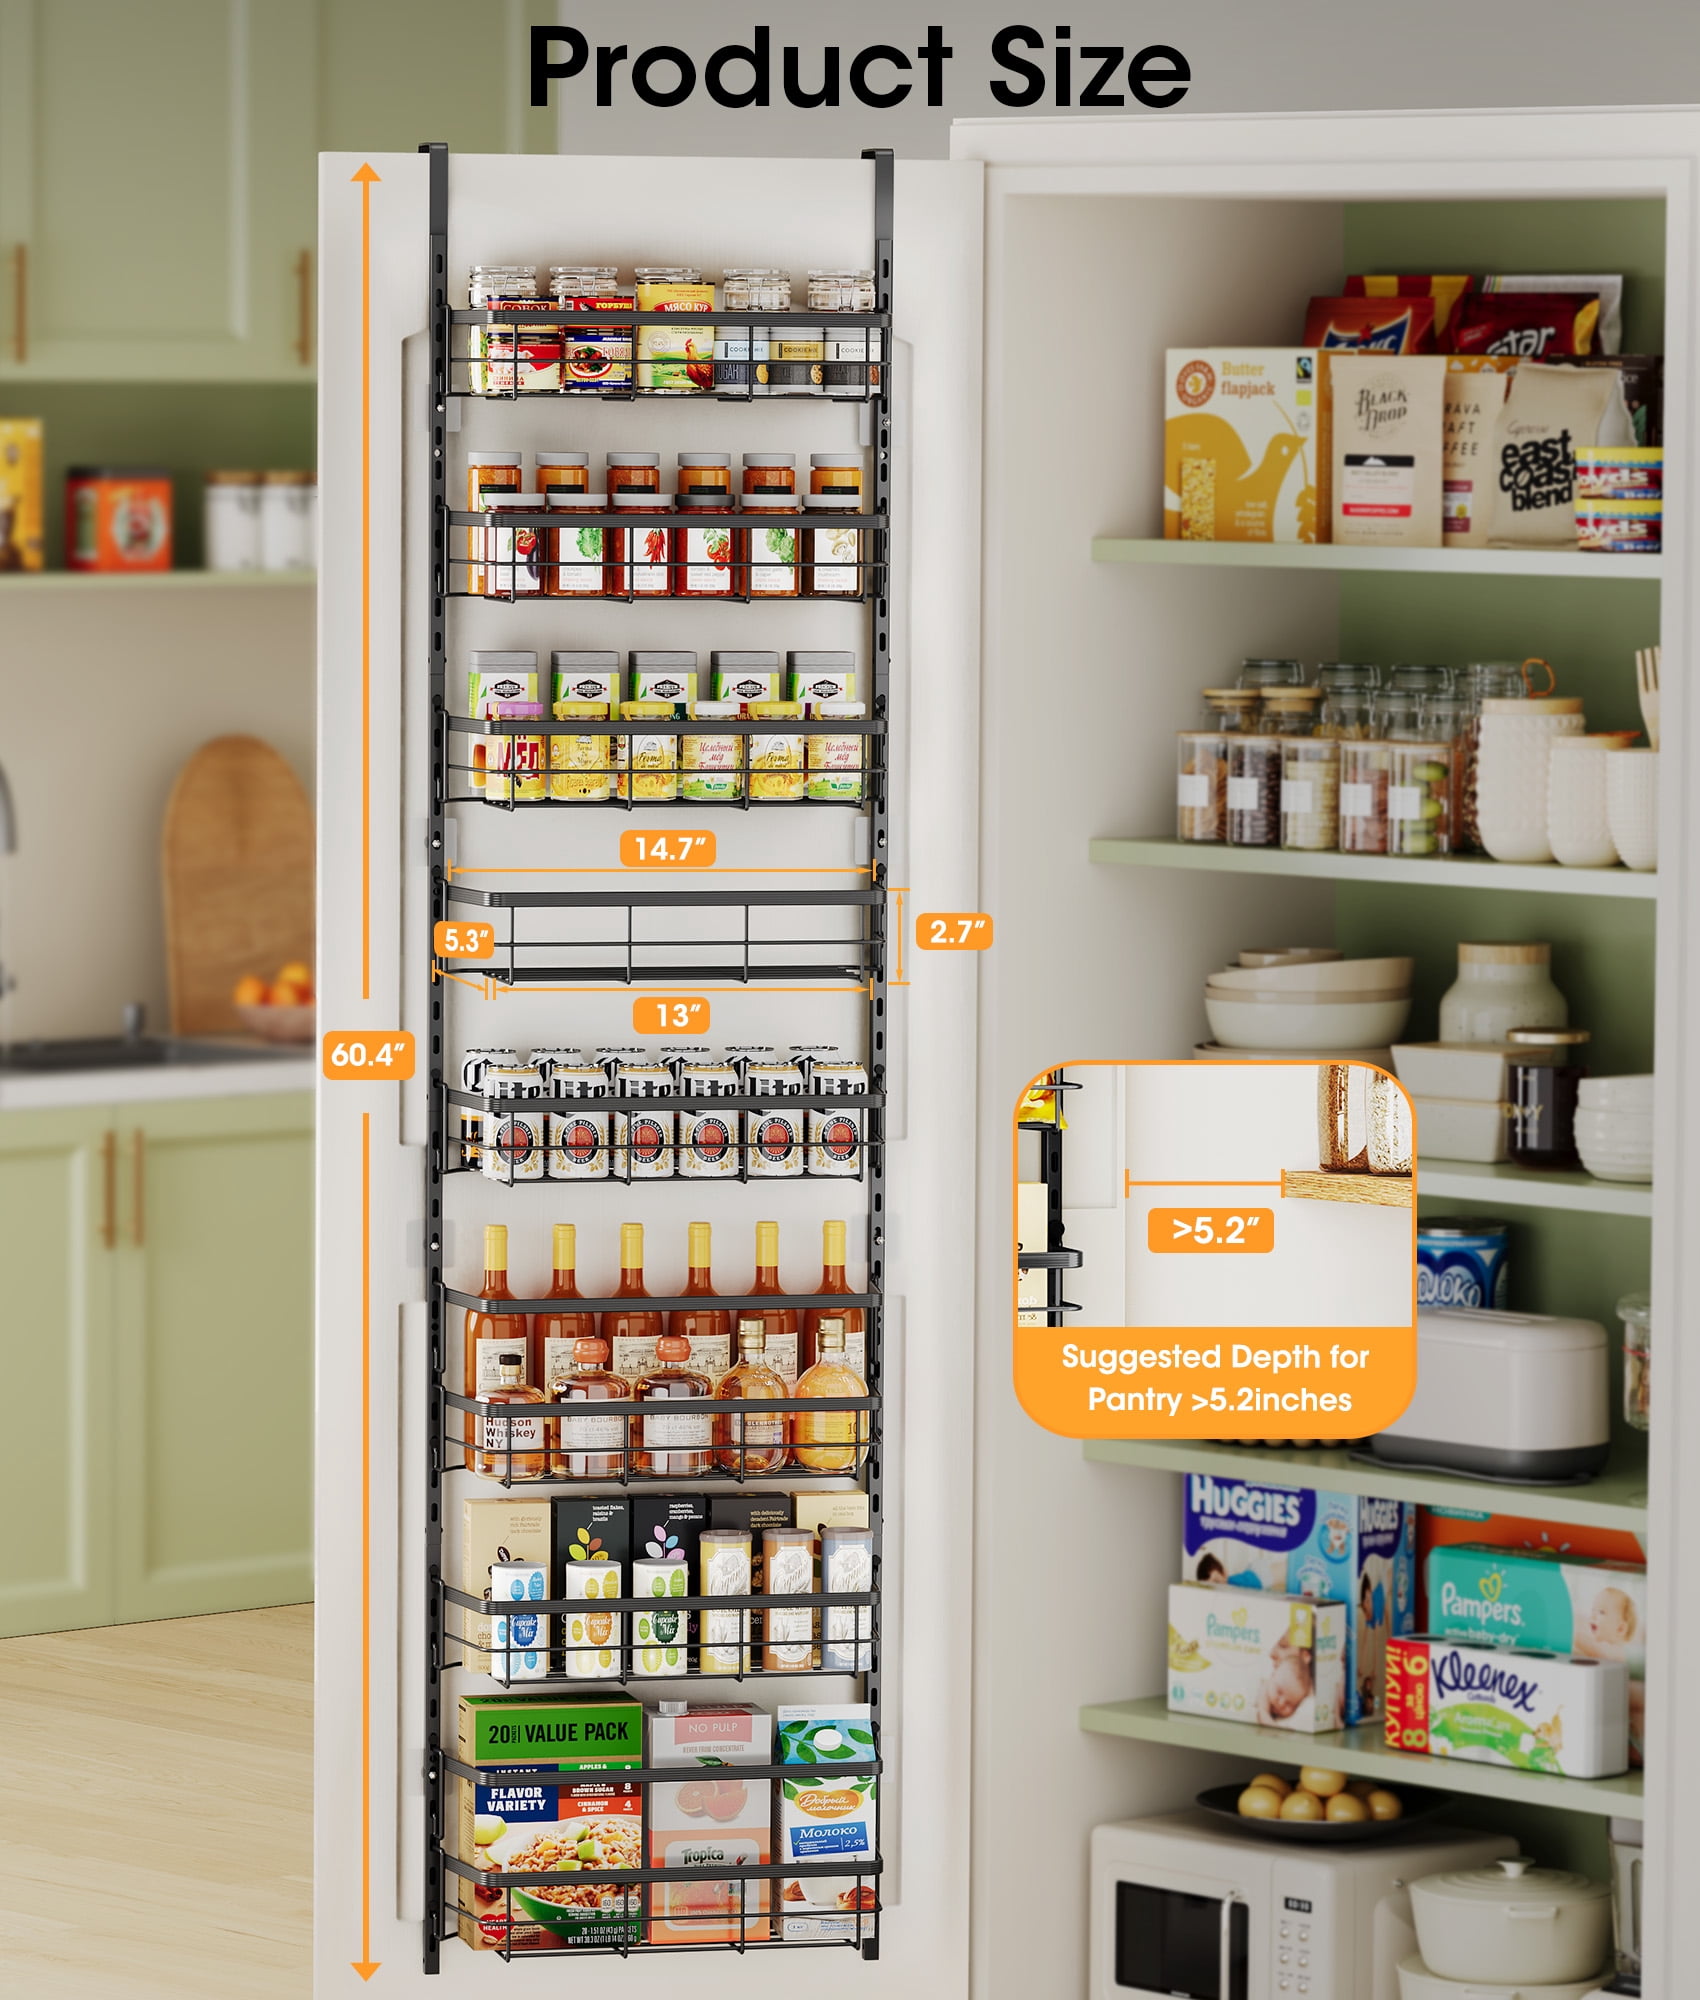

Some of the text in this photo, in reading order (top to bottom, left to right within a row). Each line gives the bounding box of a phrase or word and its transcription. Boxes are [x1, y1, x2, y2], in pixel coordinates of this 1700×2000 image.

[1221, 361, 1264, 376] Butter
[1220, 381, 1275, 399] flapjack
[1357, 388, 1408, 416] BLACK
[1444, 402, 1481, 415] RAVA
[1501, 429, 1572, 468] east
[1511, 481, 1573, 513] blend
[486, 1440, 502, 1448] NY
[1191, 1473, 1301, 1527] HUGGIES
[1441, 1581, 1523, 1626] Pampers
[1206, 1613, 1261, 1644] Pampers
[1431, 1650, 1538, 1712] Kleenex
[489, 1725, 510, 1744] 20
[525, 1723, 578, 1743] VALUE
[585, 1721, 629, 1741] PACK
[688, 1722, 738, 1733] NO PULP
[491, 1786, 542, 1800] FLAVOR
[487, 1799, 546, 1812] VARIETY
[624, 1800, 631, 1808] 4
[800, 1826, 858, 1839] Молоко
[844, 1838, 866, 1849] 2,5%
[681, 1846, 724, 1865] Tropica
